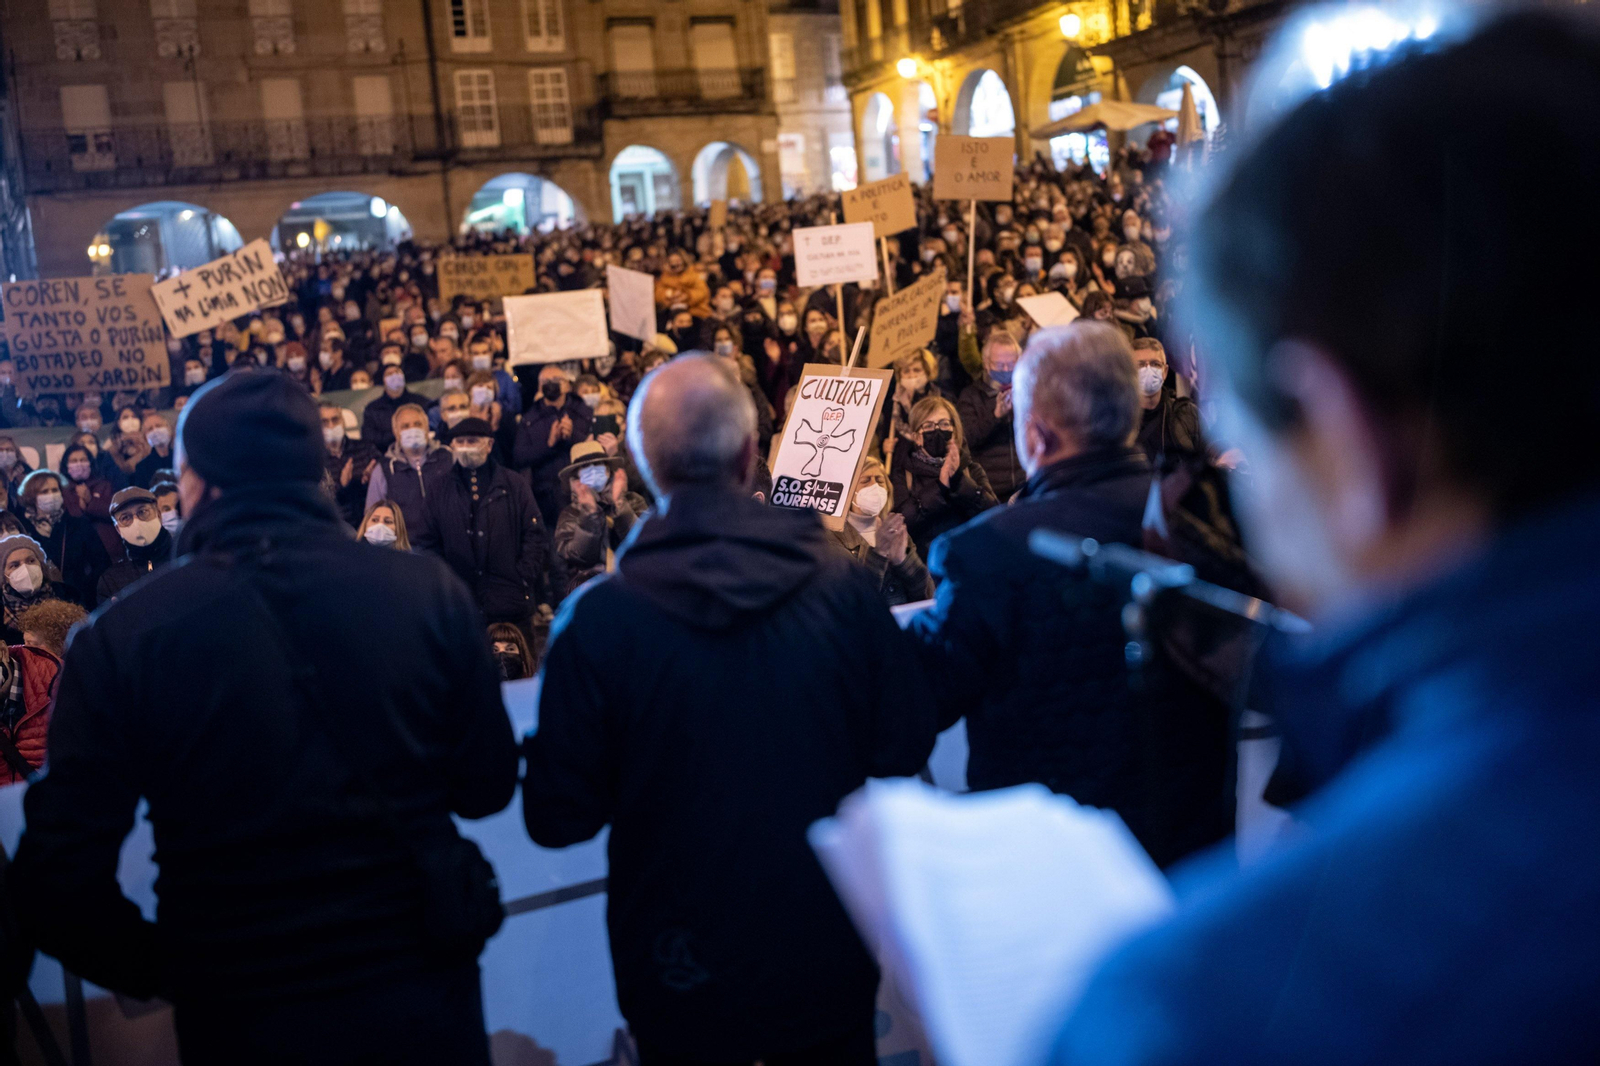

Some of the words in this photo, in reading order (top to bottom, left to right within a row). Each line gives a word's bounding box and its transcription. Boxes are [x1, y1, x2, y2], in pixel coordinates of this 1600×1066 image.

[961, 141, 989, 154] ISTO
[954, 172, 964, 183] O
[967, 170, 1000, 182] AMOR
[850, 194, 857, 204] A
[6, 281, 89, 307] COREN,
[95, 278, 126, 299] SE
[174, 305, 195, 323] NA
[242, 271, 285, 306] NON
[12, 310, 86, 328] TANTO
[96, 305, 137, 324] VOS
[13, 329, 82, 351] GUSTA
[90, 329, 101, 344] O
[107, 320, 163, 347] PURÍN
[12, 348, 103, 372] BOTADEO
[119, 348, 145, 364] NO
[27, 373, 75, 390] VOSO
[801, 378, 872, 407] CULTURA
[773, 493, 837, 513] OURENSE
